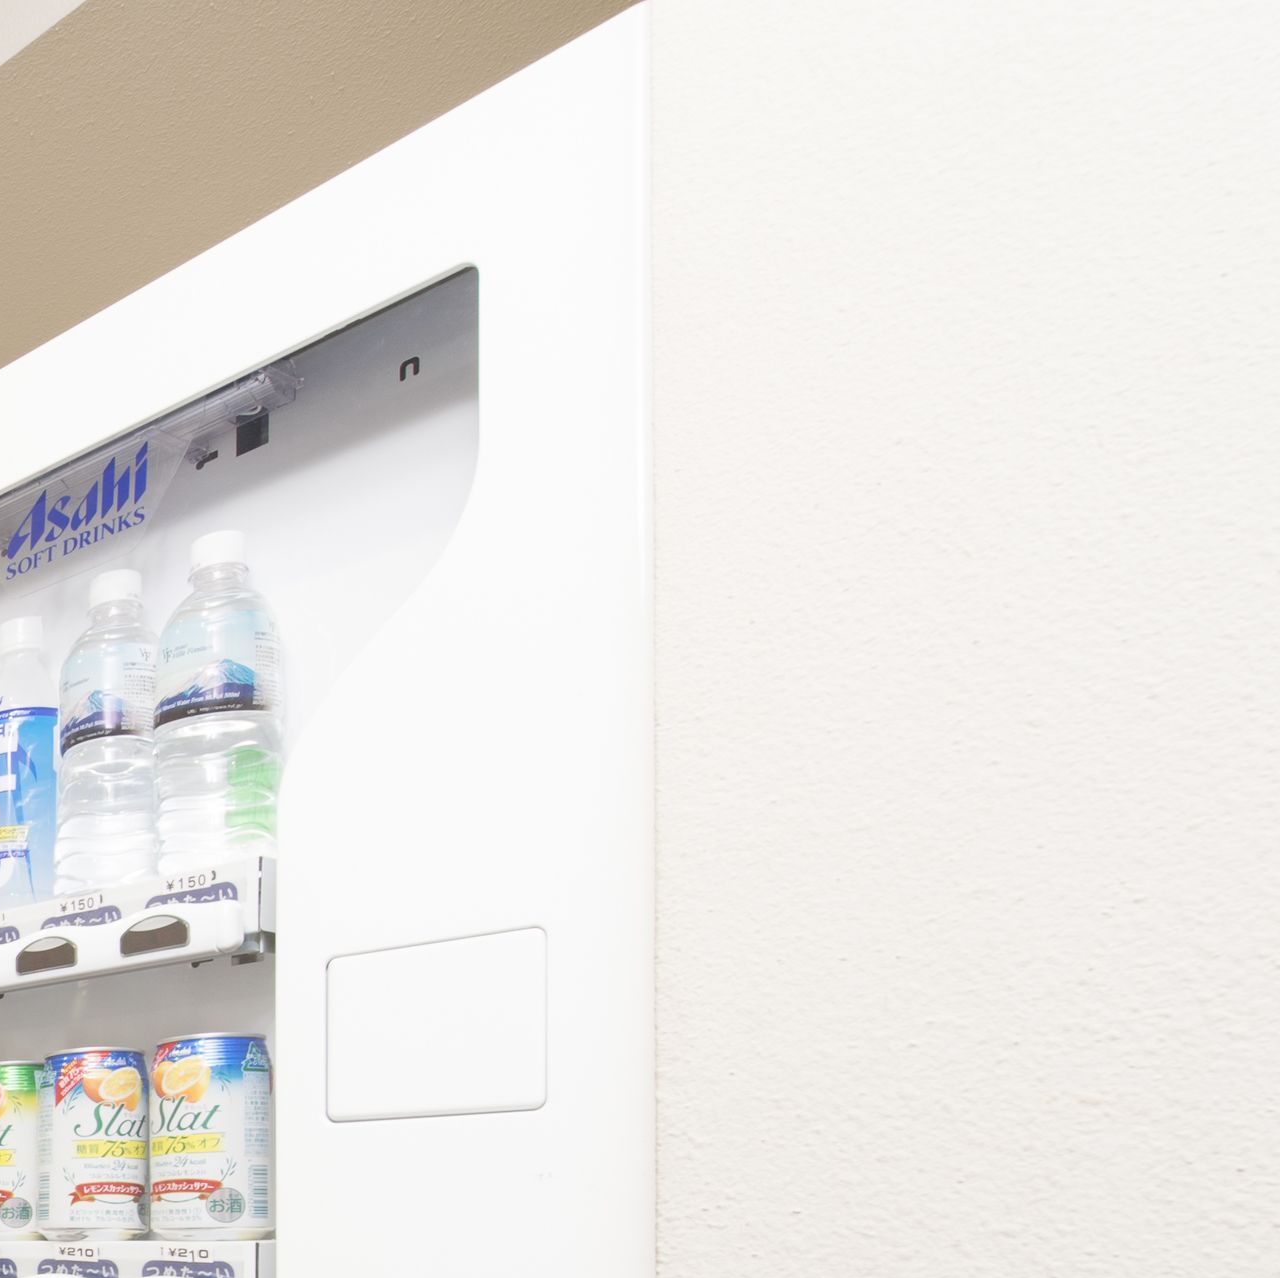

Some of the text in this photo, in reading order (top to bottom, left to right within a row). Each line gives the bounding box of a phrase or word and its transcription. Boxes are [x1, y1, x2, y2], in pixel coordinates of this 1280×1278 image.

[7, 441, 148, 559] Asahi
[6, 506, 145, 580] SOFT DRINKS
[165, 874, 206, 891] ¥150
[60, 898, 95, 912] ¥150
[74, 1101, 147, 1138] Slat
[152, 1096, 222, 1135] Slat
[1, 1206, 31, 1220] お酒
[209, 1198, 242, 1214] お酒
[59, 1247, 94, 1258] ¥210
[168, 1248, 210, 1263] ¥210
